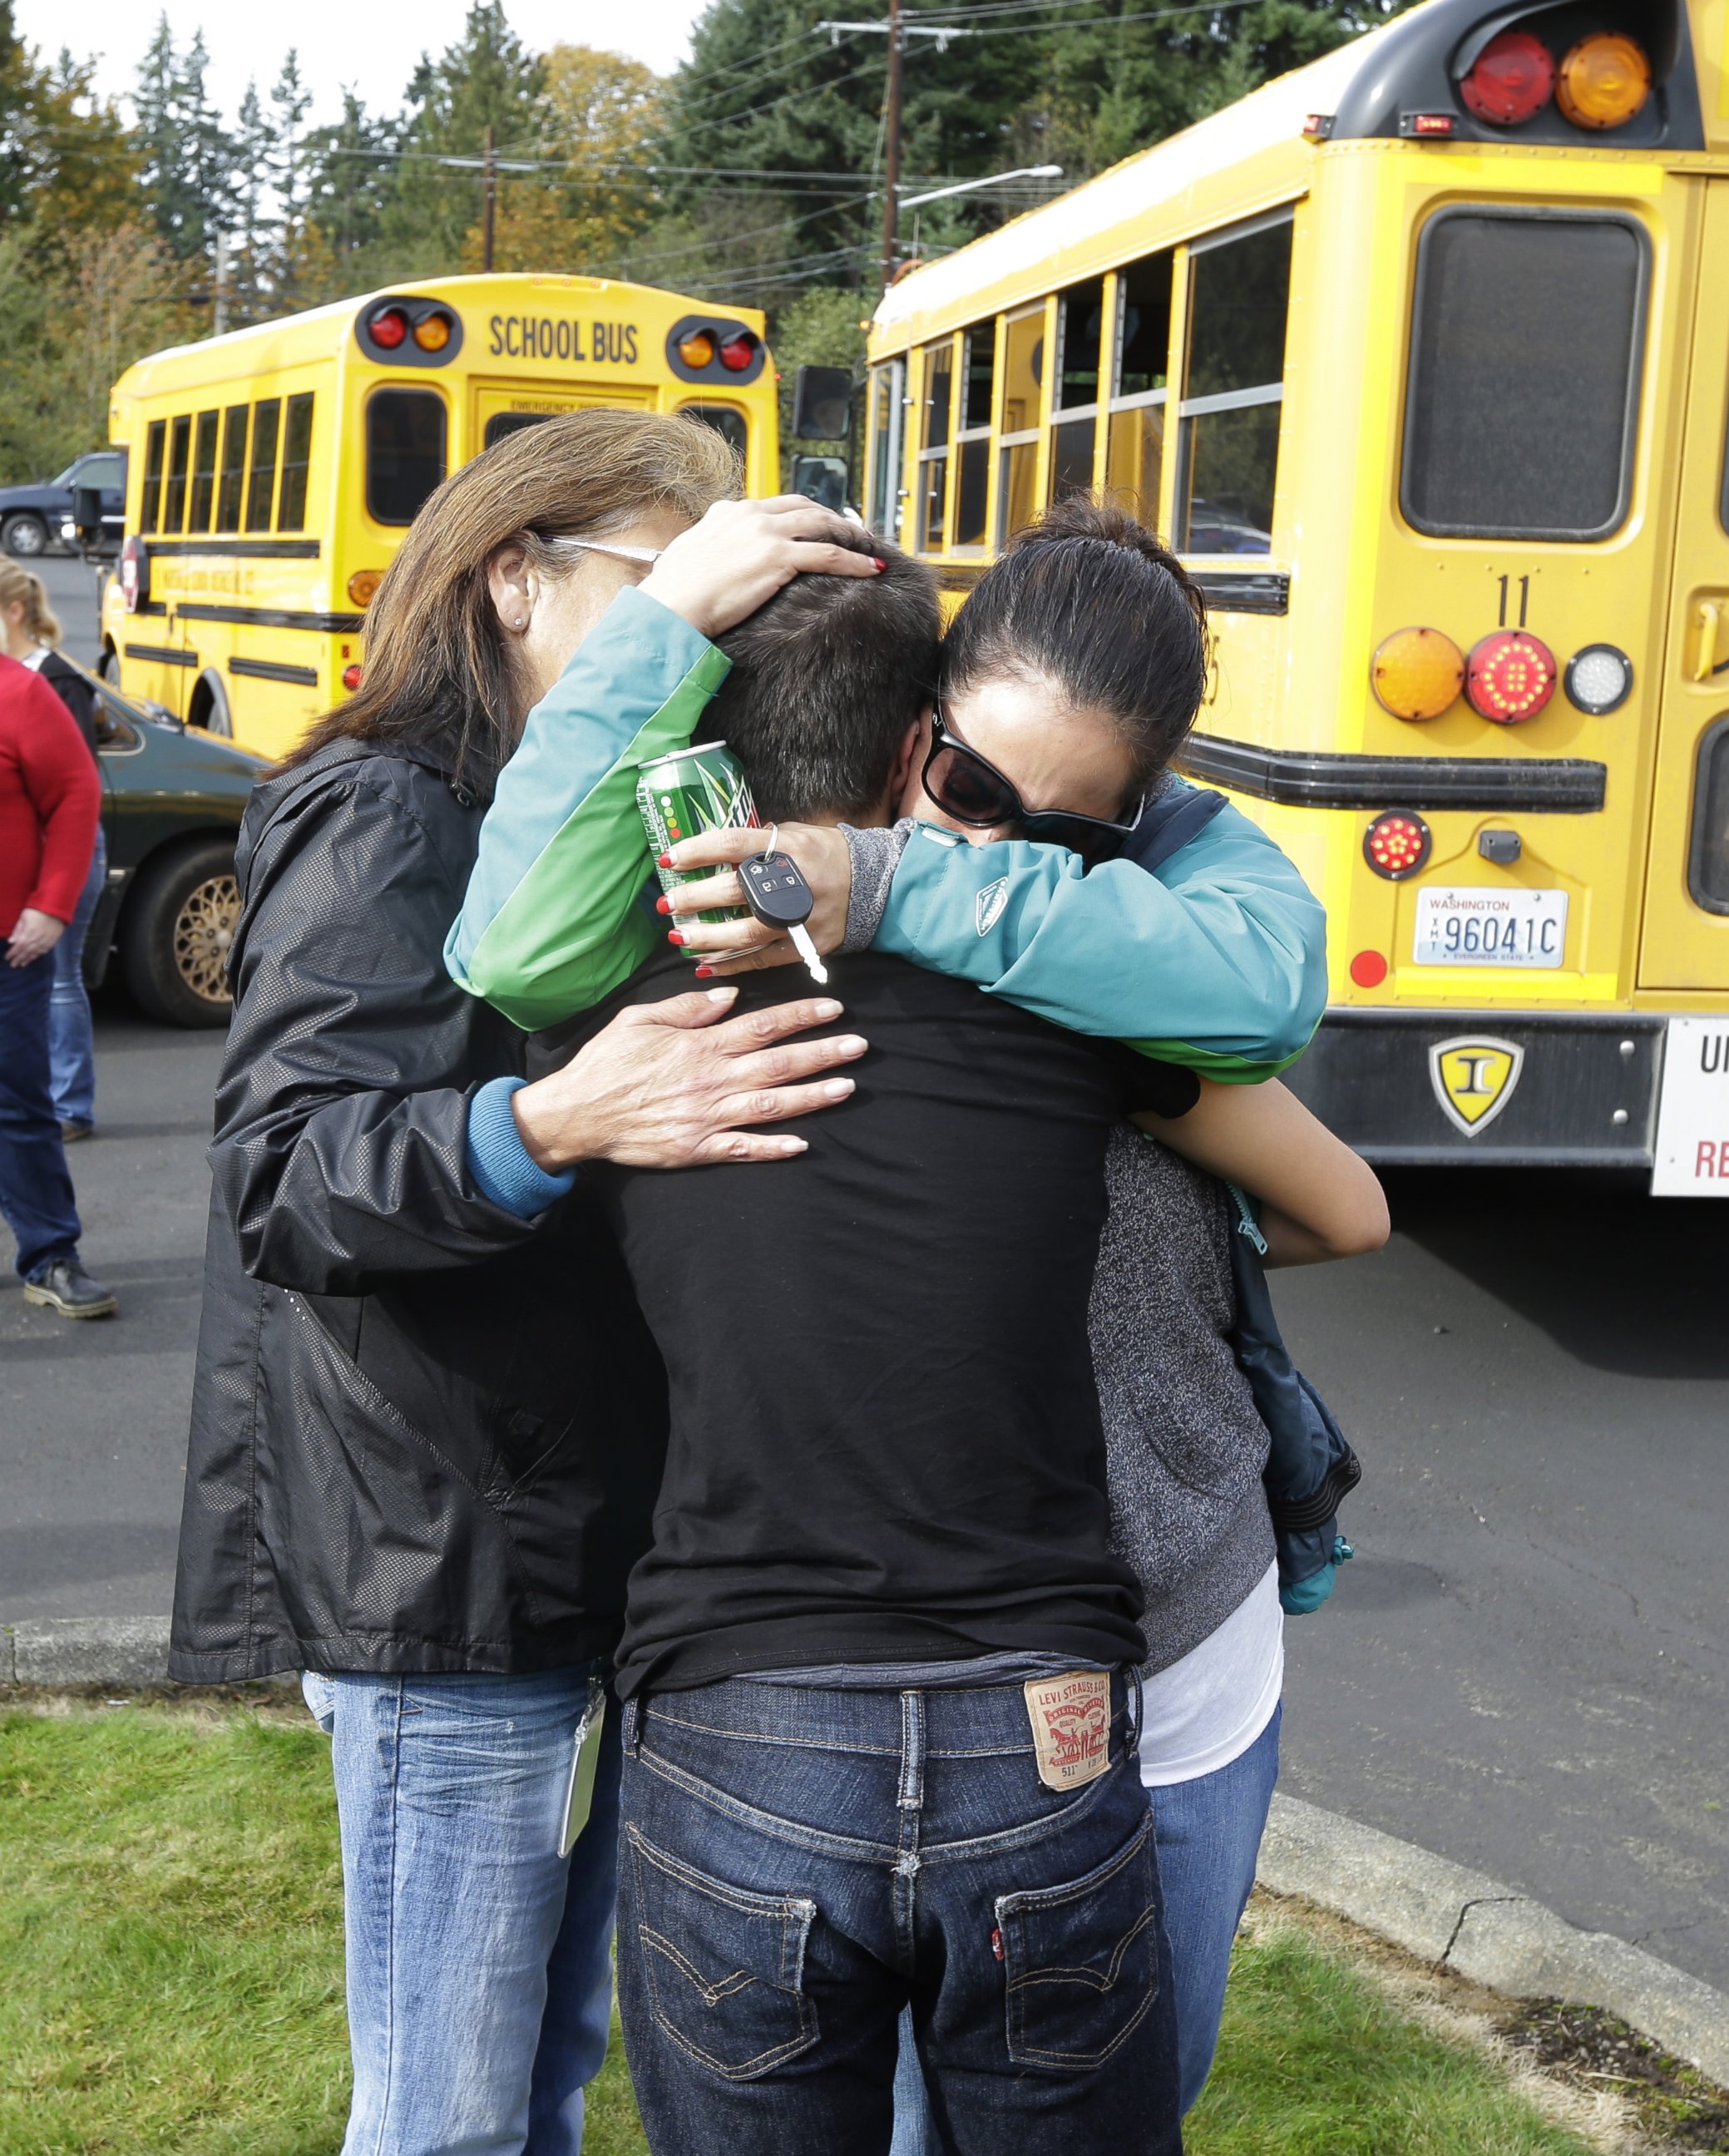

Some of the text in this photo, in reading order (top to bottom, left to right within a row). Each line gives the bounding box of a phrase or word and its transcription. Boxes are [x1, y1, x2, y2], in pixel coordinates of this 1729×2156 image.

[489, 315, 638, 364] SCHOOL BUS
[1498, 574, 1529, 628] 11
[1430, 900, 1510, 911] WASHINGTON
[1445, 917, 1557, 954] 96041C
[1039, 1691, 1061, 1705] LEVI
[1064, 1681, 1094, 1699] STRAUSS
[1049, 1707, 1081, 1722] ORIGINAL
[1060, 1718, 1076, 1728] QUALITY
